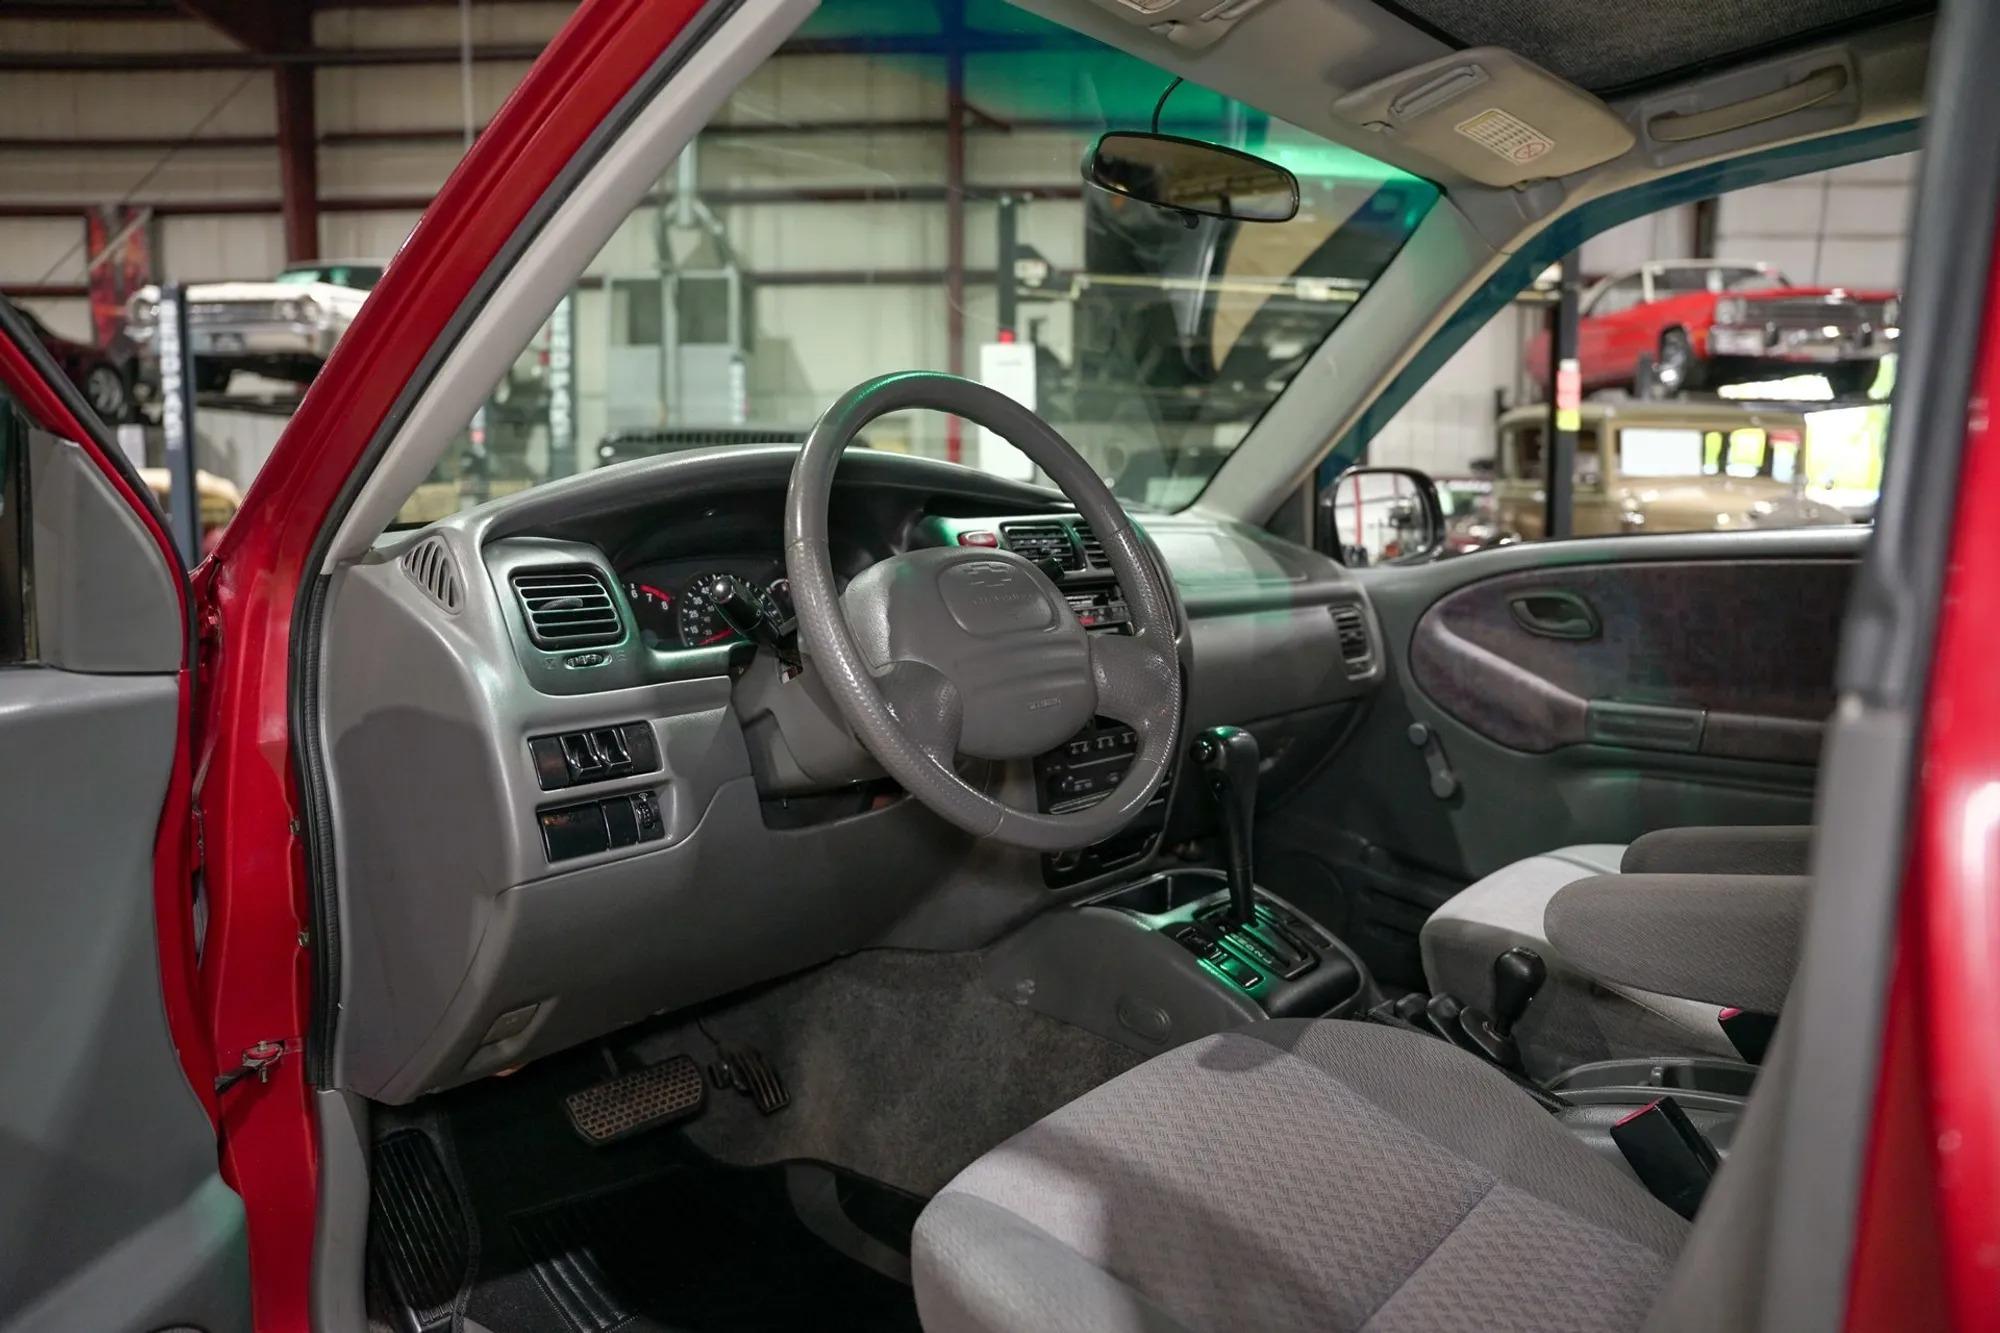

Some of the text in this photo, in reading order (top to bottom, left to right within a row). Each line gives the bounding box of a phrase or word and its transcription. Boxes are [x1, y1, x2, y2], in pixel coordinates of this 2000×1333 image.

[631, 590, 638, 599] 6
[646, 593, 653, 602] 7
[661, 601, 668, 610] 8
[689, 610, 699, 618] 25
[690, 625, 699, 634] 15
